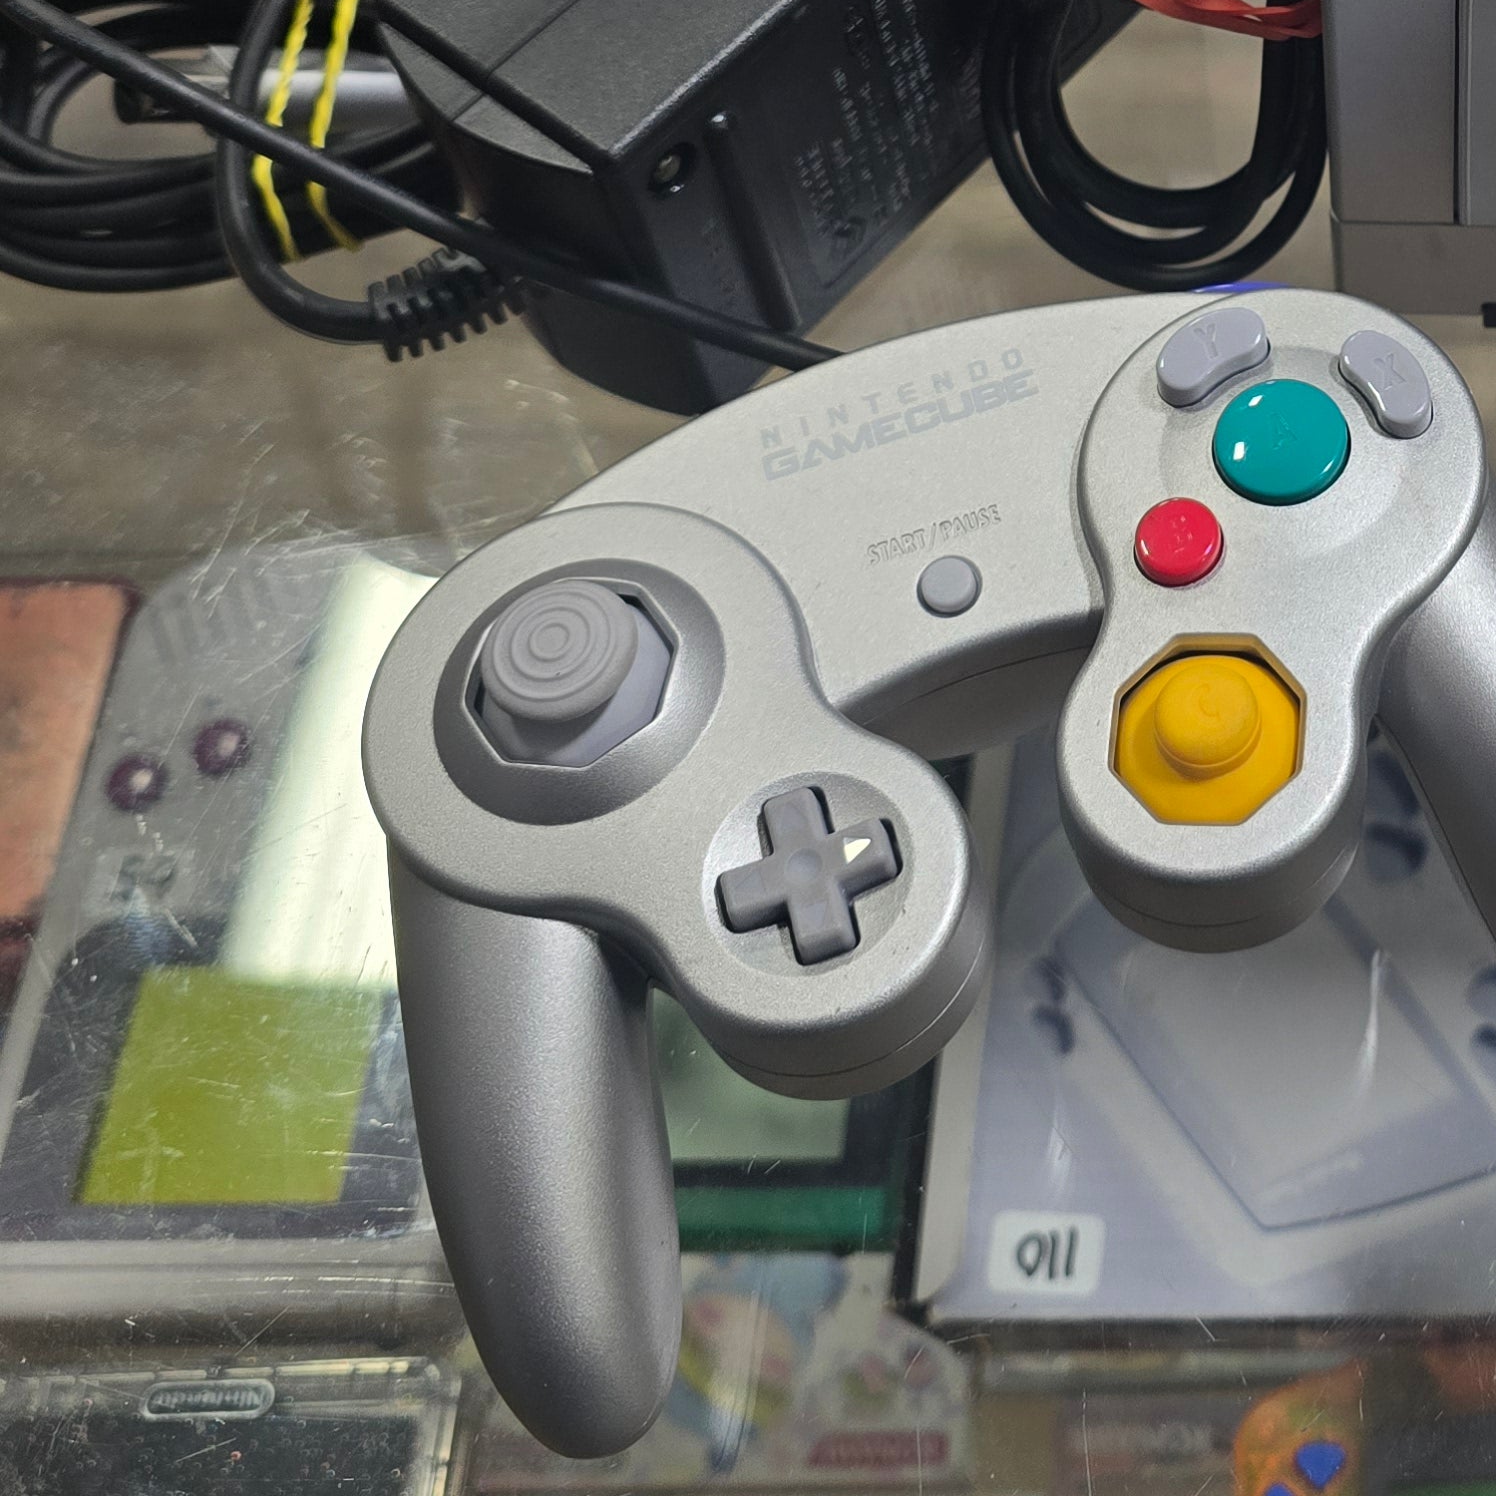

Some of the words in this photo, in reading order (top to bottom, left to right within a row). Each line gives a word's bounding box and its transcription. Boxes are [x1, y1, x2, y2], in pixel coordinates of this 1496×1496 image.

[760, 348, 1025, 449] NINTENDO
[762, 368, 1040, 482] GAMECUBE
[866, 503, 1002, 565] START/PAUSE
